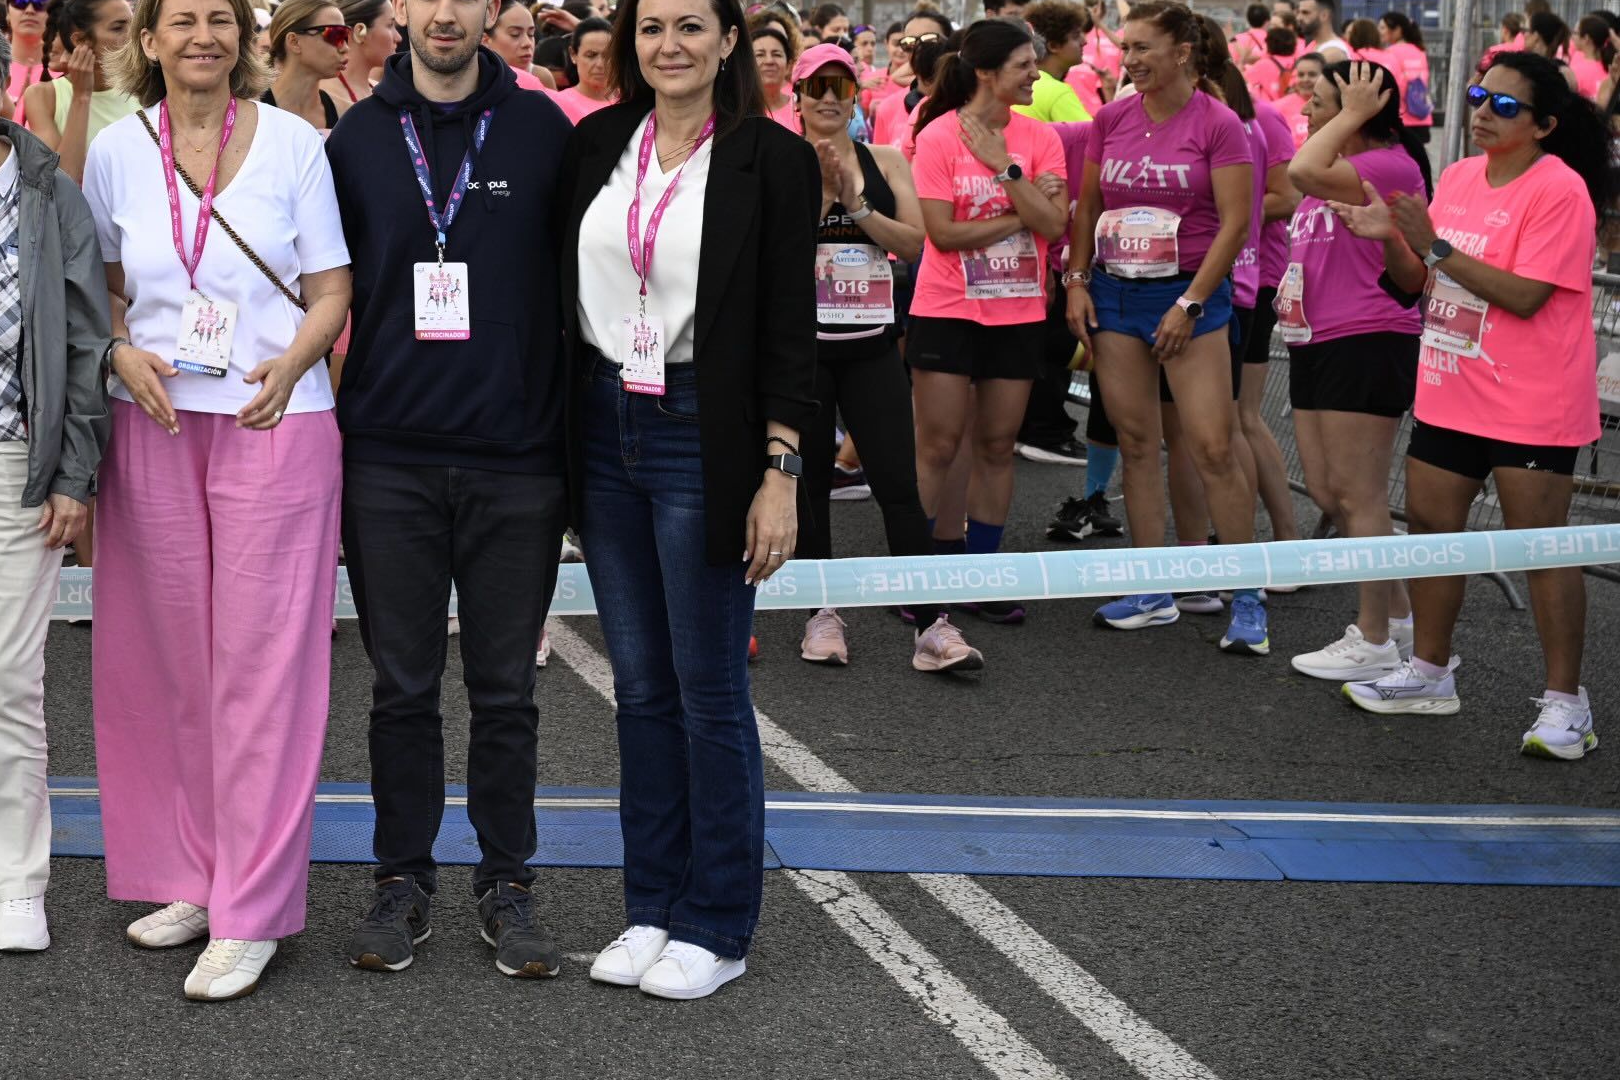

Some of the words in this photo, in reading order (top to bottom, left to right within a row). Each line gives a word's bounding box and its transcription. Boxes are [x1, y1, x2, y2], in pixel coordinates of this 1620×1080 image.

[467, 180, 508, 191] ocpus
[492, 190, 511, 198] energy
[447, 203, 455, 226] octopus
[1120, 237, 1150, 250] 016
[989, 257, 1020, 270] 016
[834, 280, 869, 294] 016
[1428, 298, 1458, 318] 016
[177, 361, 222, 376] ORGANIZACIÓN
[626, 383, 662, 393] PATROCINADOR
[1316, 542, 1466, 571] SPORTLIFE
[1095, 555, 1242, 582] SPORTLIFE
[873, 565, 1019, 593] SPORTLIFE
